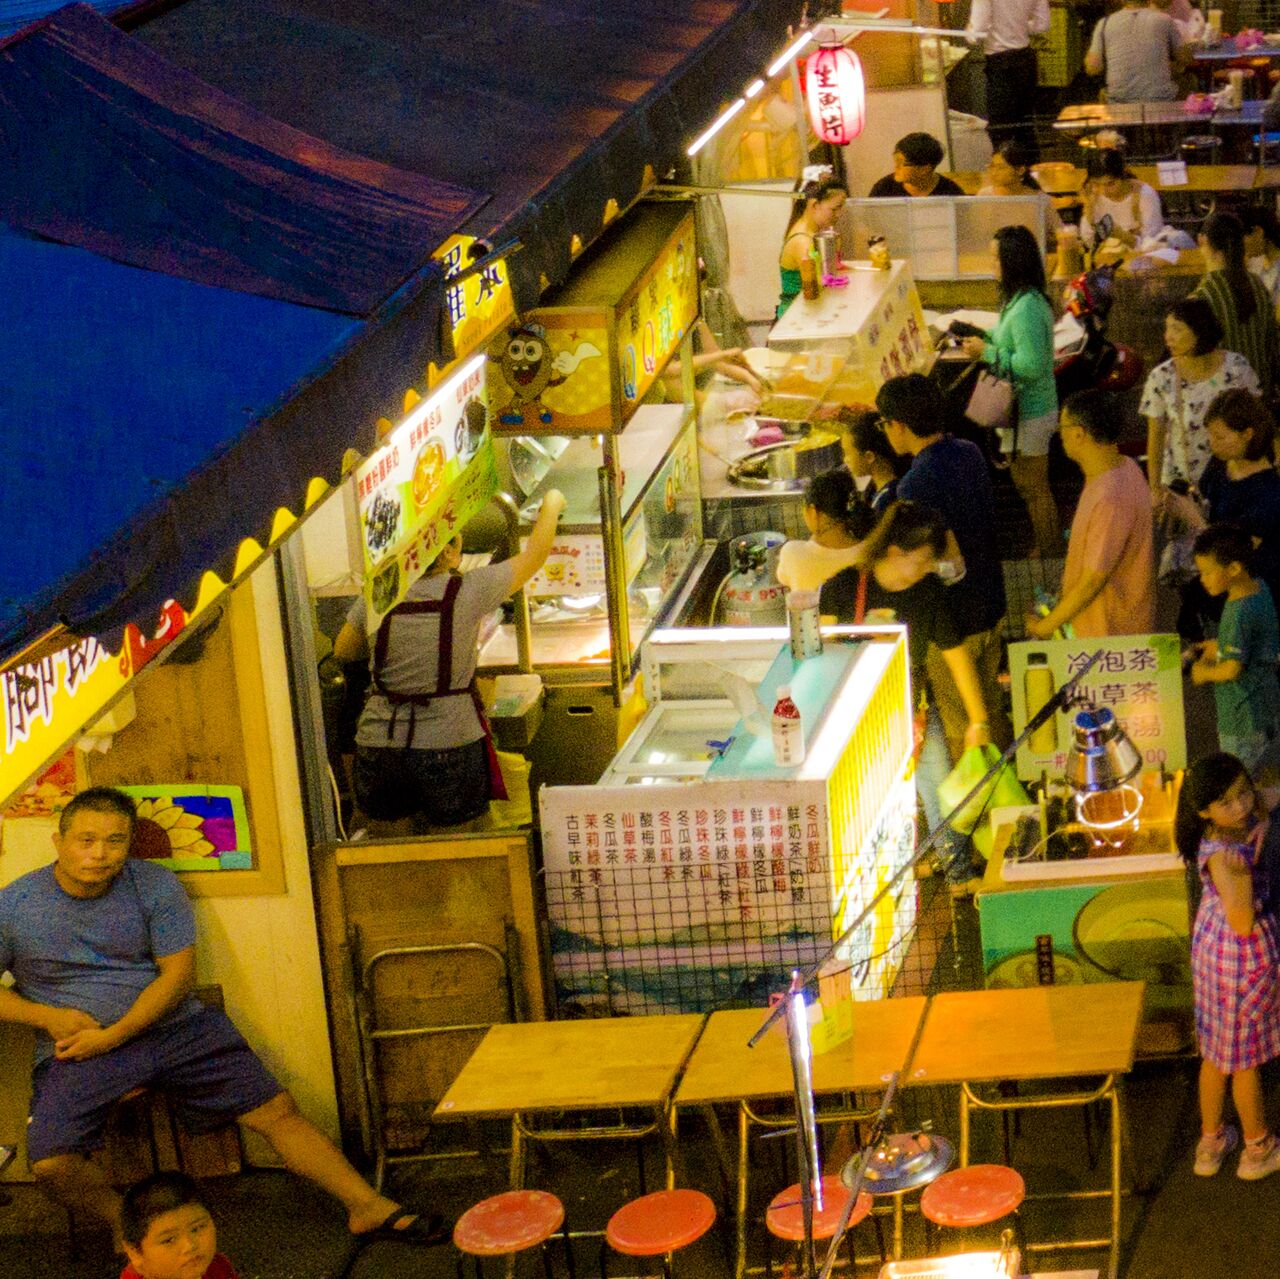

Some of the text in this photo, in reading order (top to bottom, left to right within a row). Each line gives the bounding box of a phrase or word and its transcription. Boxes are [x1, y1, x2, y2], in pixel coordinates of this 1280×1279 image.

[815, 63, 843, 137] 生魚片
[1067, 648, 1157, 673] 冷泡茶
[1067, 681, 1159, 705] 仙草茶
[565, 814, 584, 901] 古早味紅茶
[584, 813, 602, 886] 茉莉綠茶
[602, 812, 619, 865] 冬瓜茶
[621, 812, 638, 864] 仙草茶
[639, 812, 656, 865] 酸梅湯
[658, 810, 676, 880] 冬瓜紅茶
[676, 810, 695, 880] 冬瓜綠茶
[695, 809, 713, 879] 珍珠冬瓜
